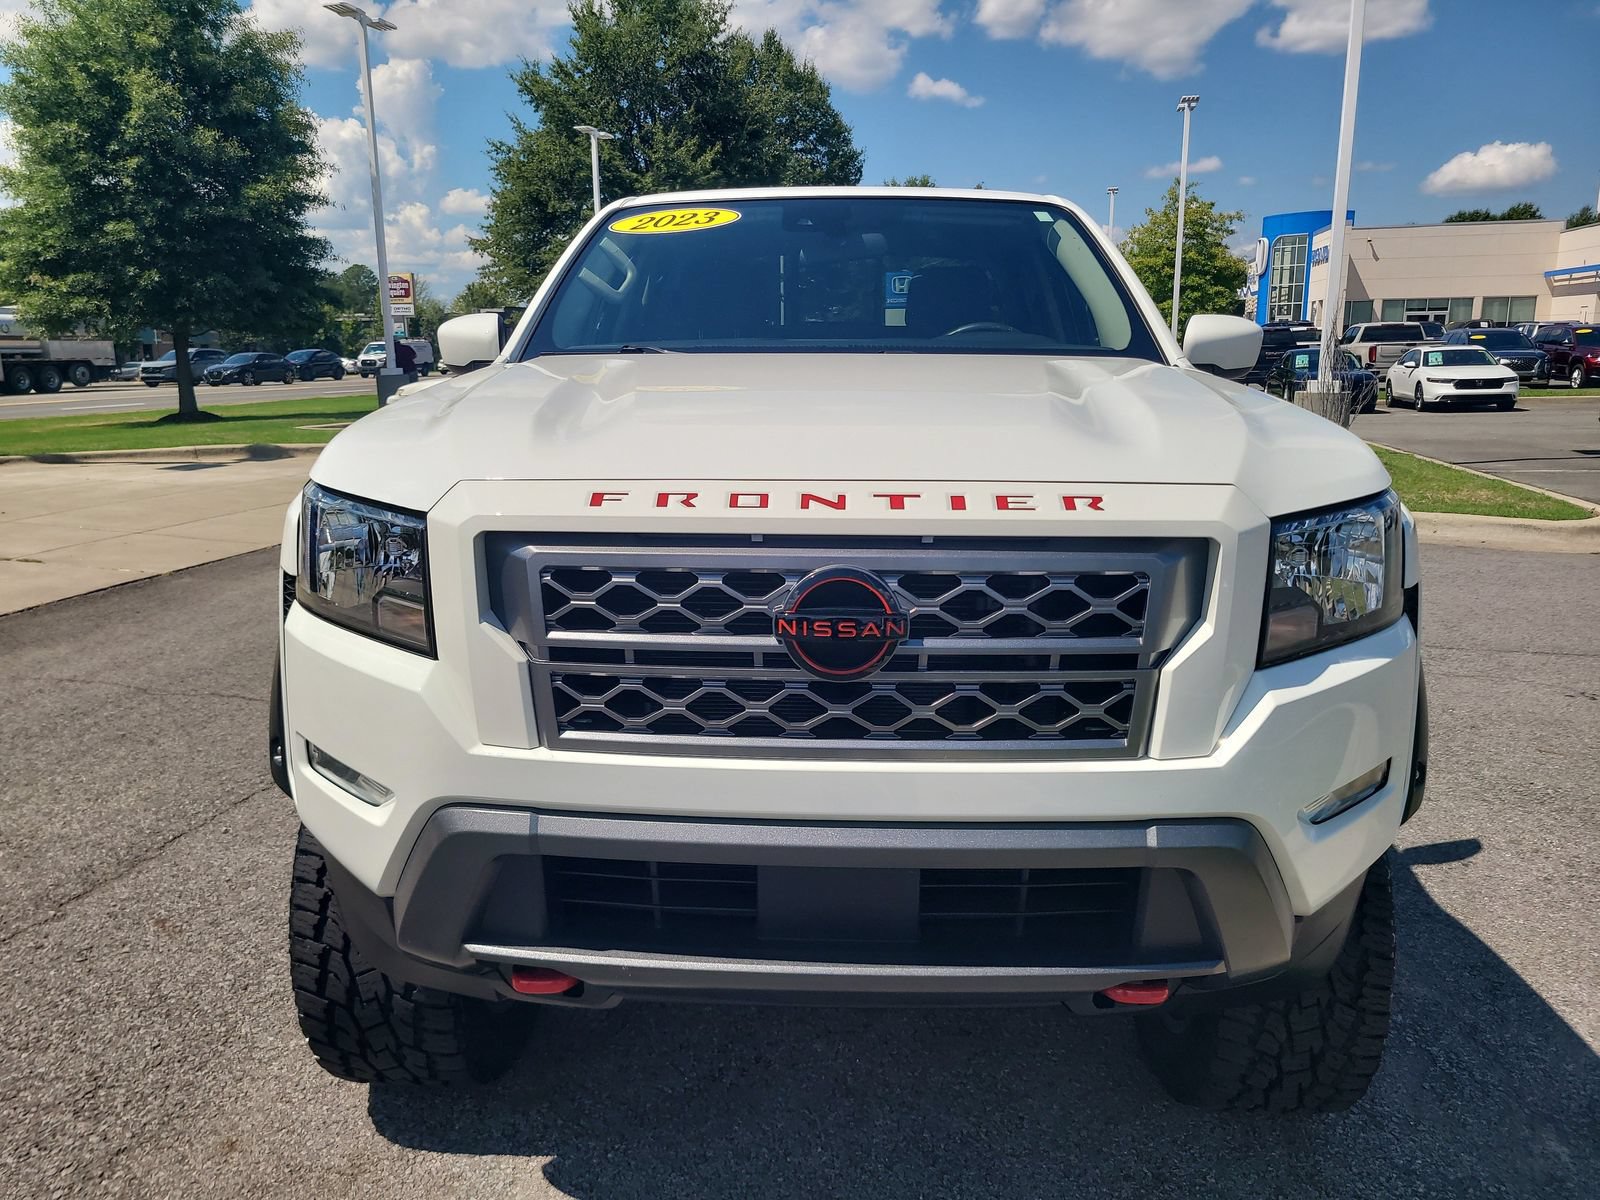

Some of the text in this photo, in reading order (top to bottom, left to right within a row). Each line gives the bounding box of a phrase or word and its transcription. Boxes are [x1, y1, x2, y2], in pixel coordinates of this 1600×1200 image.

[631, 211, 720, 231] 2023
[589, 492, 1105, 511] FRONTIER
[777, 618, 906, 638] NISSAN
